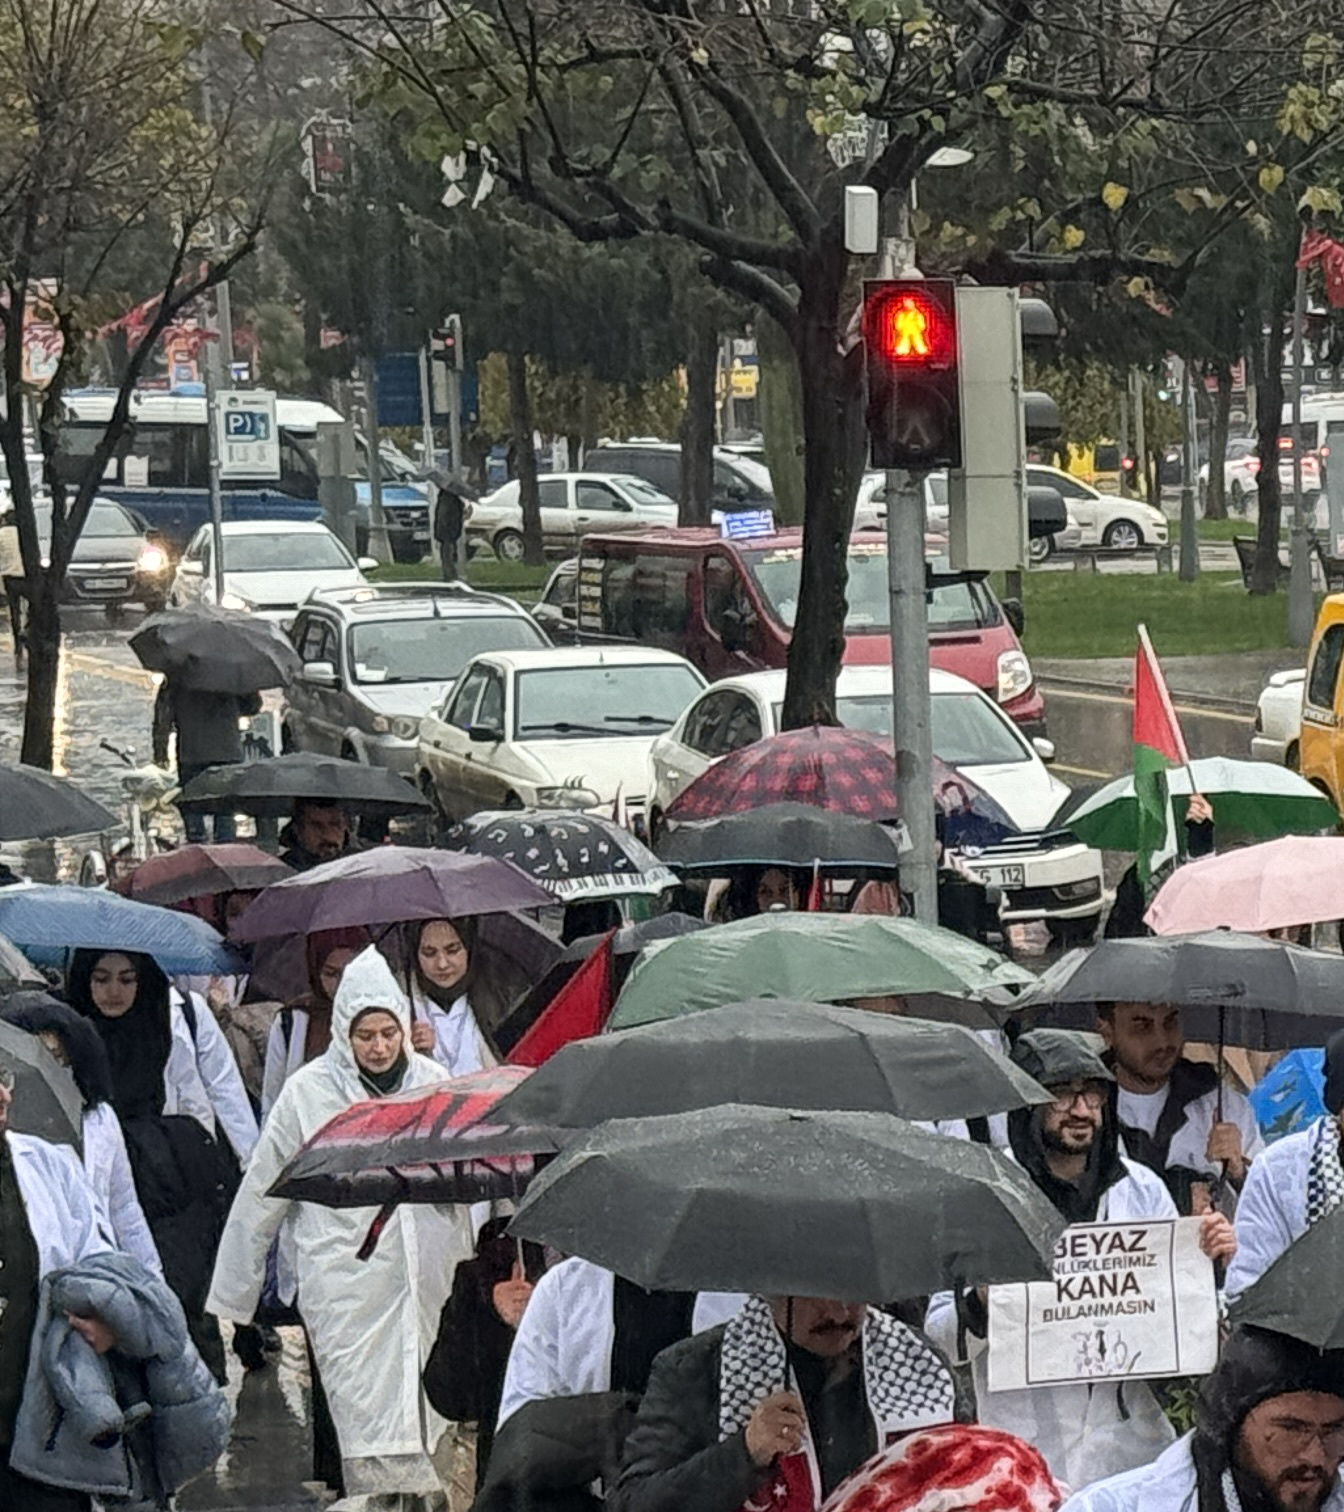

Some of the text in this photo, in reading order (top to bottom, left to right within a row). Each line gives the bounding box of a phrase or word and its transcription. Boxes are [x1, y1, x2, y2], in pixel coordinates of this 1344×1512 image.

[229, 414, 244, 433] P
[1001, 868, 1021, 883] 112
[1053, 1253, 1157, 1275] NLÜKLERİMİZ
[1056, 1272, 1141, 1302] KANA
[1043, 1299, 1155, 1322] BULANMASIN
